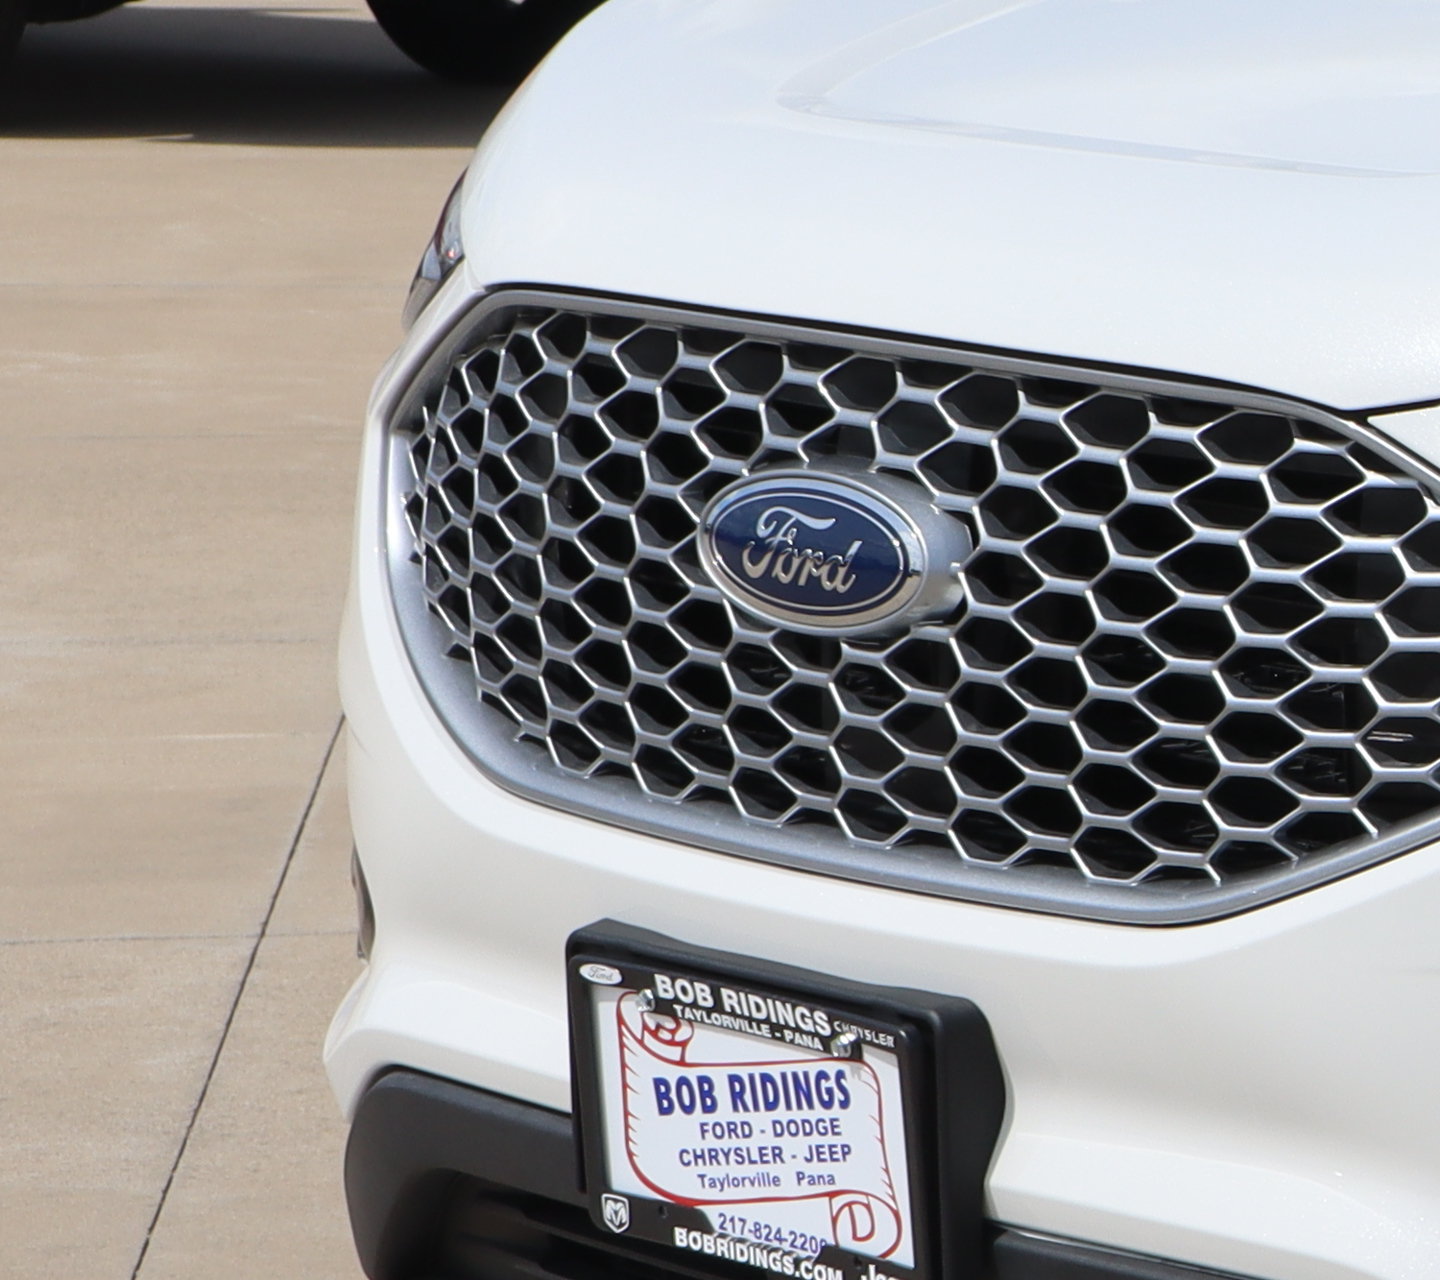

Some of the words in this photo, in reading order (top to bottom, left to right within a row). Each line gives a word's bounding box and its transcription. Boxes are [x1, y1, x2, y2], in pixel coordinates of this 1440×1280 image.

[742, 506, 864, 593] Ford
[654, 973, 715, 1009] BOB
[720, 987, 832, 1036] RIDINGS
[673, 1004, 772, 1039] TAYLORVILLE
[783, 1029, 824, 1051] PANA
[653, 1075, 718, 1116] BOB
[727, 1069, 851, 1113] RIDINGS
[700, 1121, 753, 1140] FORD
[771, 1118, 842, 1138] DODGE
[679, 1146, 785, 1167] CHRYSLER
[804, 1144, 852, 1163] JEEP
[697, 1172, 781, 1192] Taylorville
[796, 1171, 836, 1186] Pana
